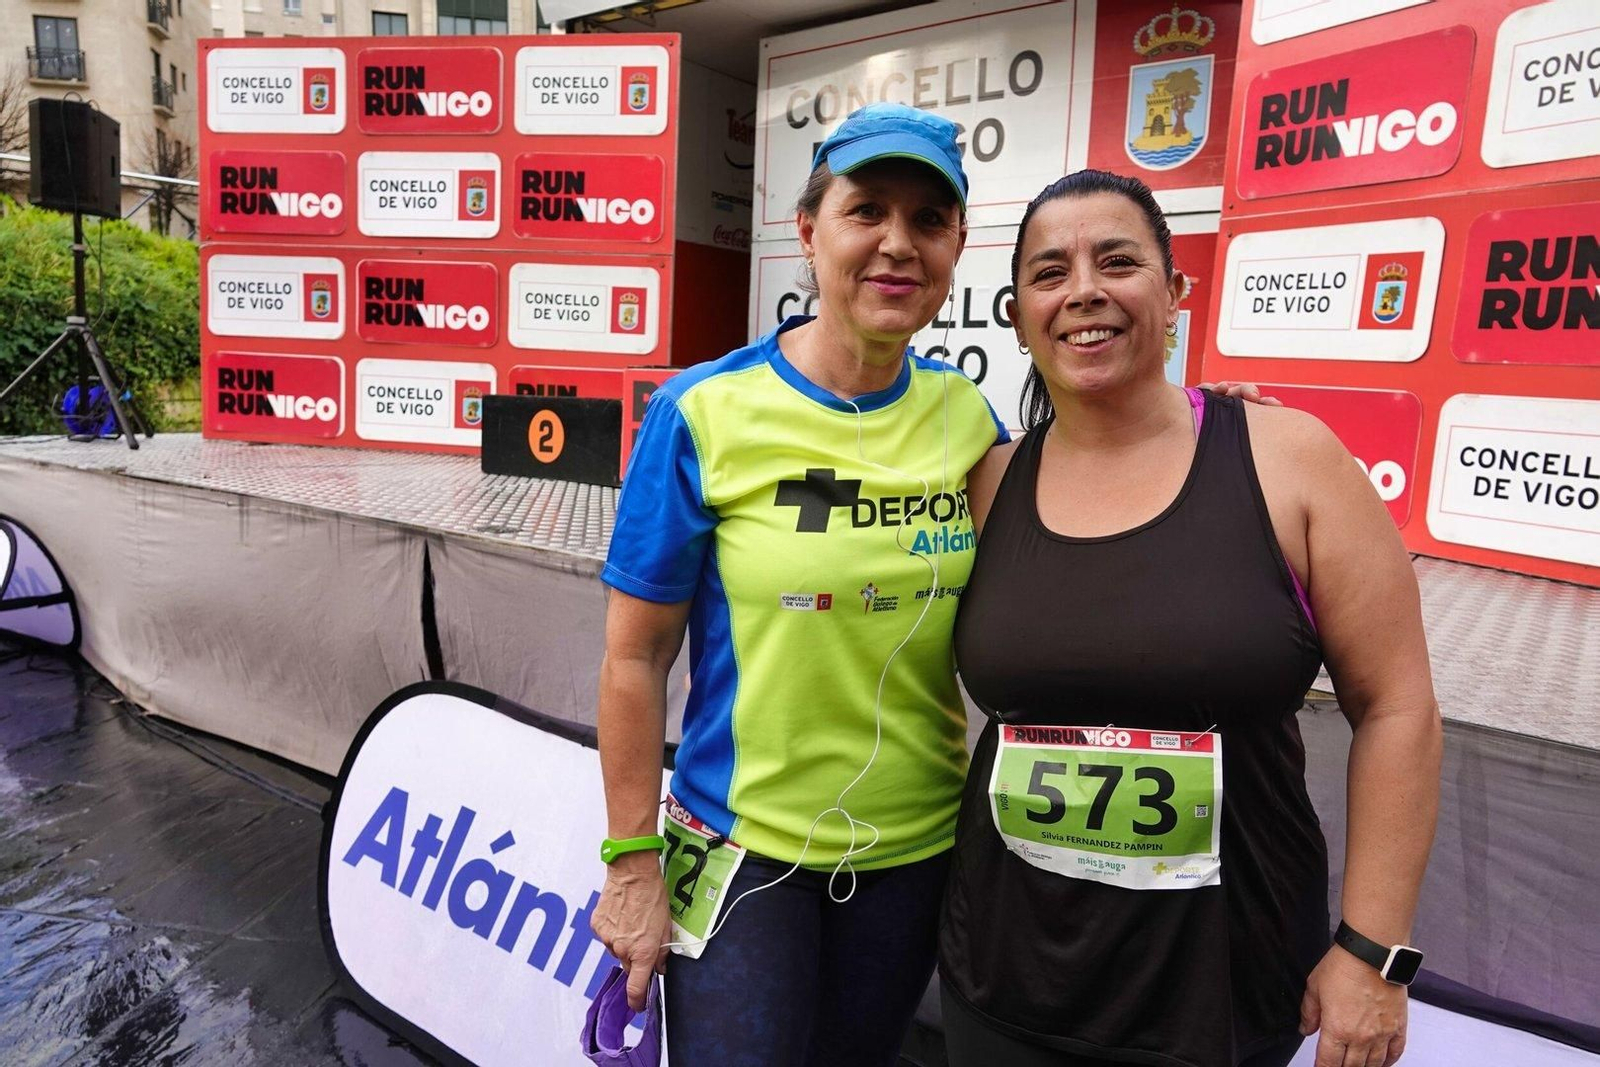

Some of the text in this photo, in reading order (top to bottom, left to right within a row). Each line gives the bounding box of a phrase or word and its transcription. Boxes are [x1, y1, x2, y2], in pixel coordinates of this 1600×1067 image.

[222, 78, 292, 90] CONCELLO
[365, 66, 425, 90] RUN
[532, 77, 609, 90] CONCELLO
[231, 93, 284, 105] DE VIGO
[541, 93, 599, 105] DE VIGO
[1259, 78, 1350, 131] RUN
[221, 168, 277, 190] RUN
[369, 180, 447, 194] CONCELLO
[522, 171, 584, 195] RUN
[379, 197, 437, 210] DE VIGO
[218, 282, 292, 296] CONCELLO
[366, 278, 423, 302] RUN
[1244, 272, 1347, 293] CONCELLO
[227, 297, 284, 311] DE VIGO
[525, 293, 600, 308] CONCELLO
[1252, 296, 1330, 315] DE VIGO
[534, 308, 590, 323] DE VIGO
[219, 369, 273, 393] RUN
[367, 386, 443, 402] CONCELLO
[376, 402, 436, 417] DE VIGO
[538, 419, 554, 453] 2
[1473, 476, 1600, 511] DE VIGO
[851, 488, 968, 529] DEPOR
[1026, 760, 1179, 837] 573
[1041, 831, 1164, 851] Silvia FERNANDEZ PAMPIN
